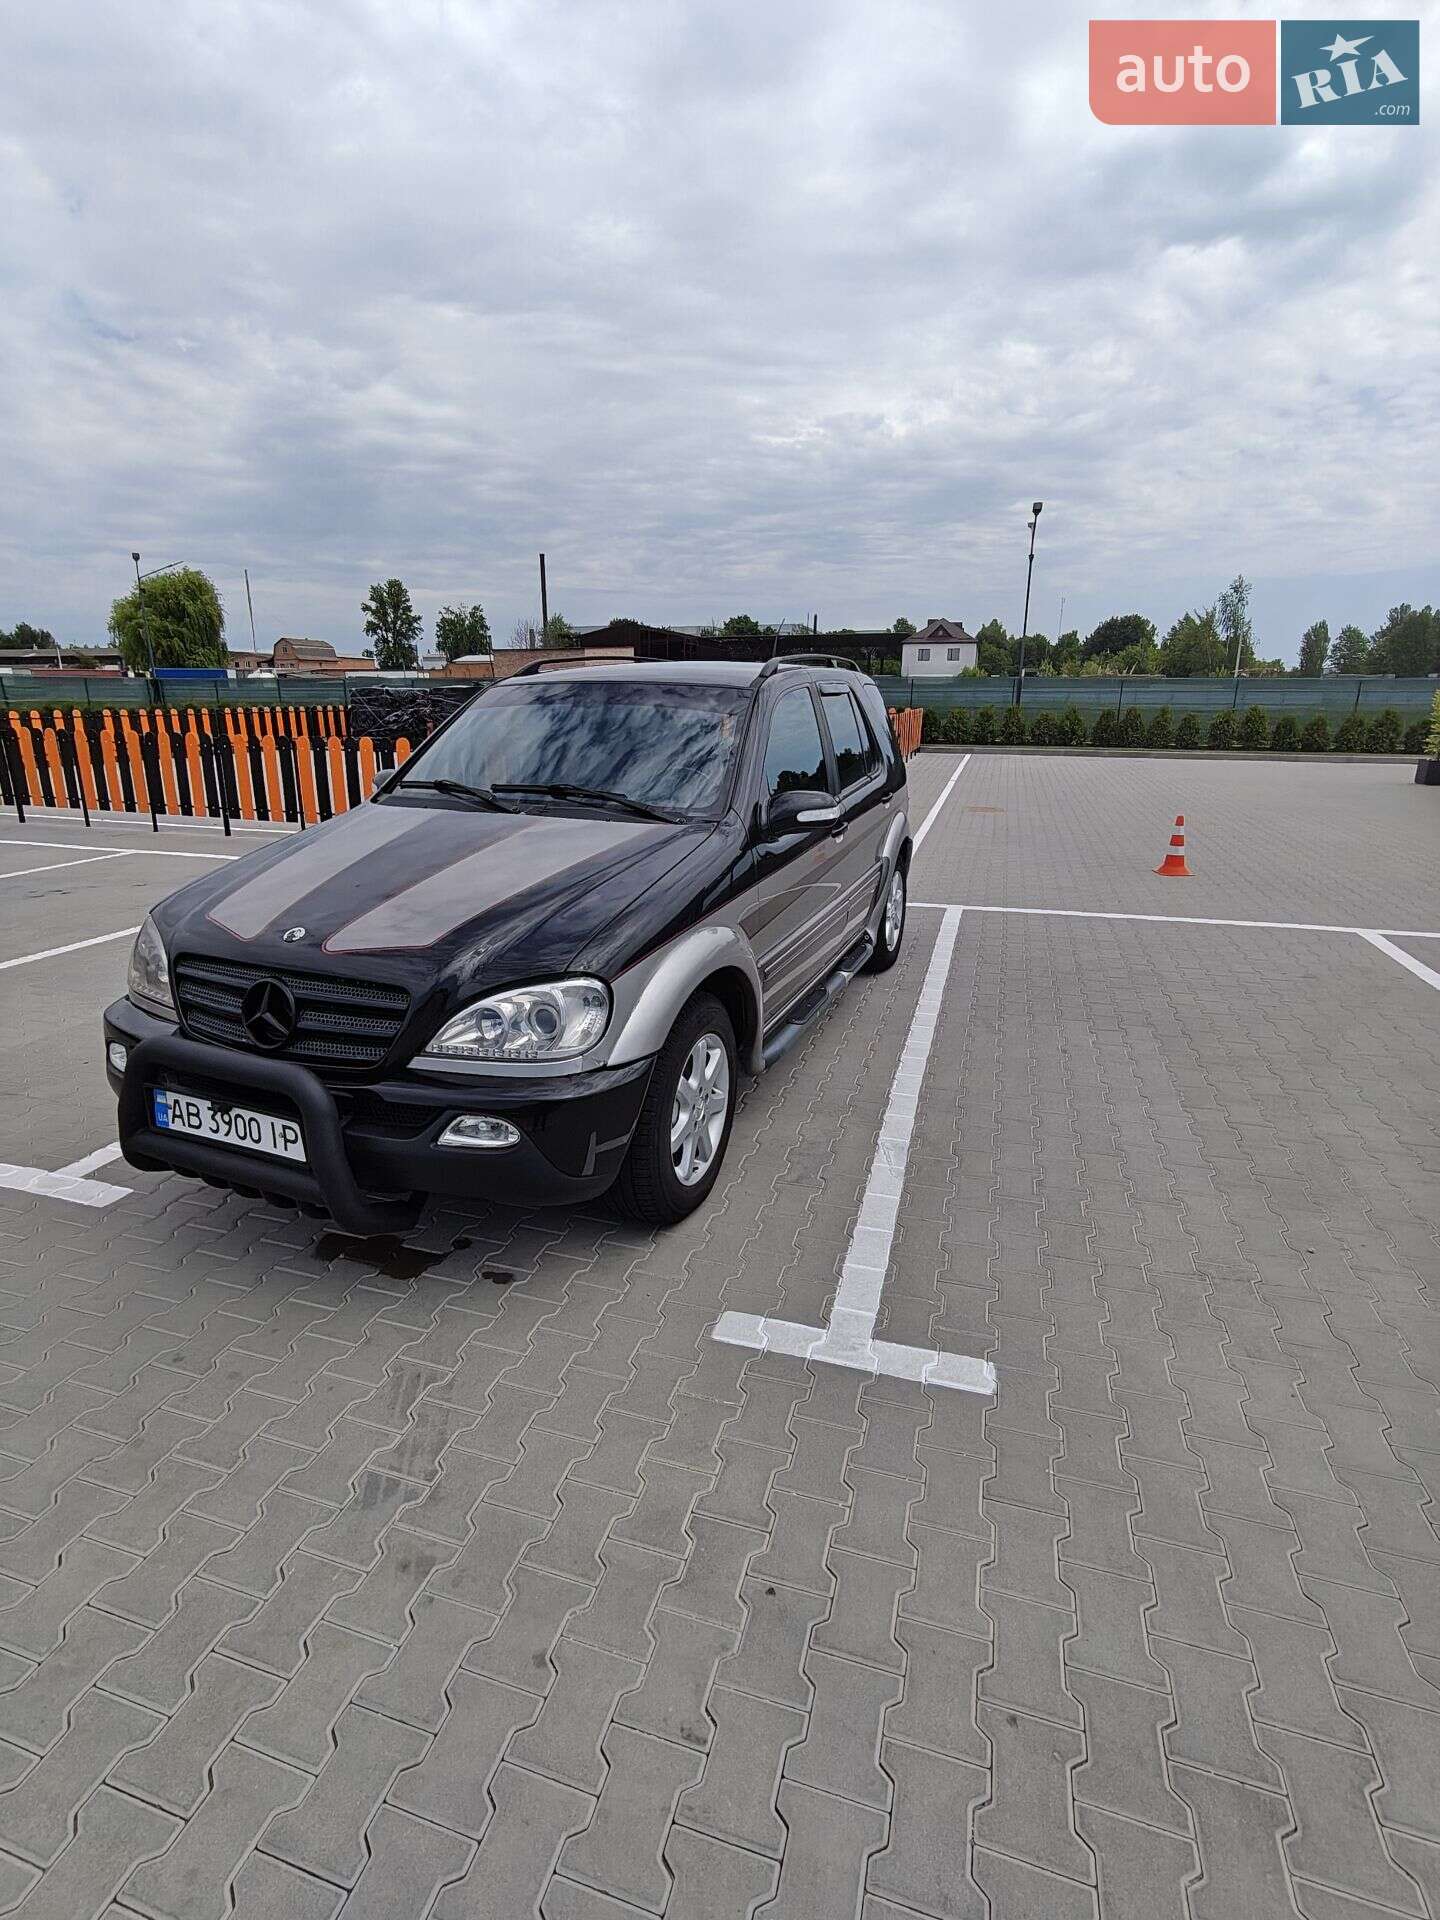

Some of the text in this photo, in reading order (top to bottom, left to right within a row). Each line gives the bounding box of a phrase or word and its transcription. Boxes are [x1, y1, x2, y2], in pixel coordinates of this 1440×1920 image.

[157, 1112, 168, 1121] UA
[171, 1099, 298, 1151] AB 3900 IP
